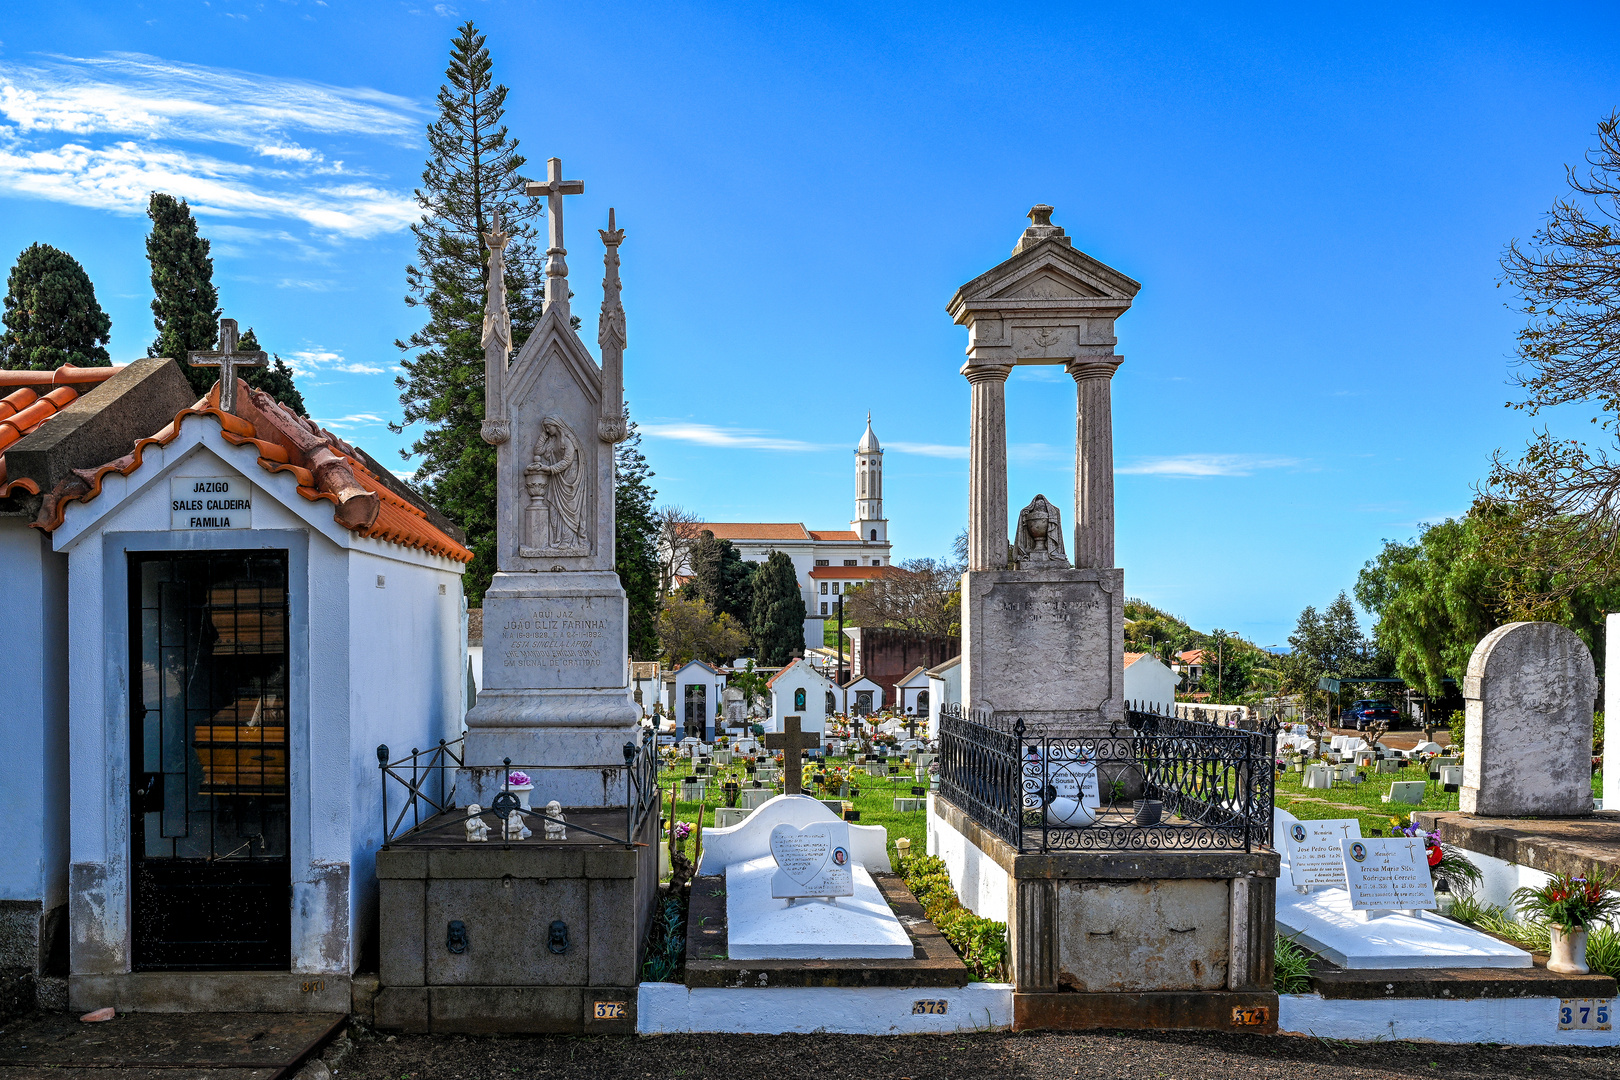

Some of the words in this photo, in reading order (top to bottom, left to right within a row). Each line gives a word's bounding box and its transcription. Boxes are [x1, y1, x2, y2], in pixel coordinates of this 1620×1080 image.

[193, 482, 229, 493] JAZIGO
[172, 500, 203, 511] SALES
[206, 499, 251, 510] CALDEIRA
[190, 517, 231, 527] FAMILIA
[533, 611, 553, 619] AQUI
[557, 611, 573, 619] JAZ
[511, 640, 530, 648] ESTA
[549, 659, 560, 667] DE
[302, 981, 325, 992] 371
[597, 1003, 625, 1017] 372
[917, 1001, 946, 1015] 373
[1235, 1009, 1265, 1023] 374
[1560, 1005, 1609, 1025] 375
